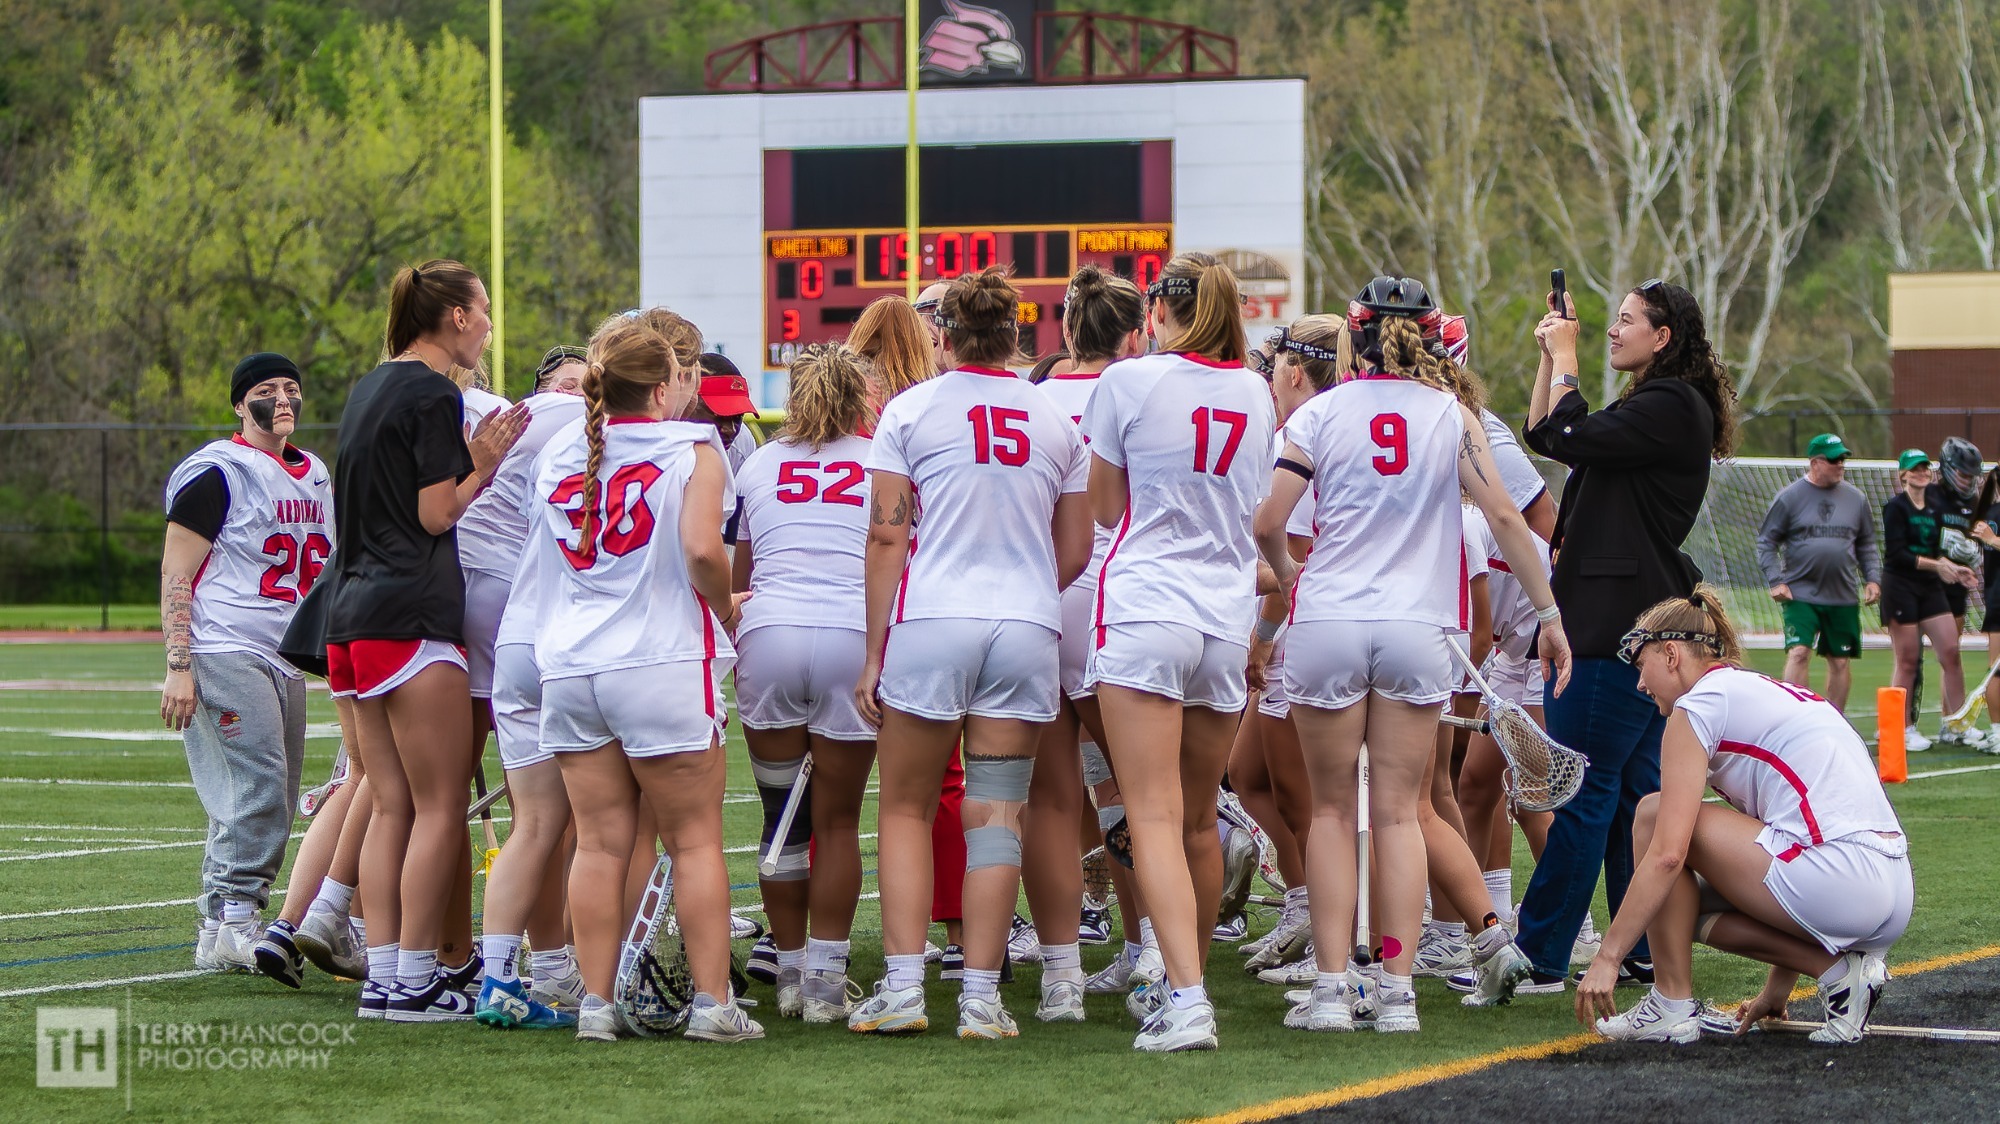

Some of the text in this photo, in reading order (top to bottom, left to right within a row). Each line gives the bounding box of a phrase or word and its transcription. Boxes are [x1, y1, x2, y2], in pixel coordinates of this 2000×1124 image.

[801, 259, 824, 299] 0
[783, 308, 800, 341] 3
[967, 404, 1031, 468] 15
[1191, 405, 1248, 478] 17
[1369, 411, 1410, 477] 9
[547, 460, 664, 573] 30
[776, 461, 865, 509] 52
[257, 531, 332, 605] 26
